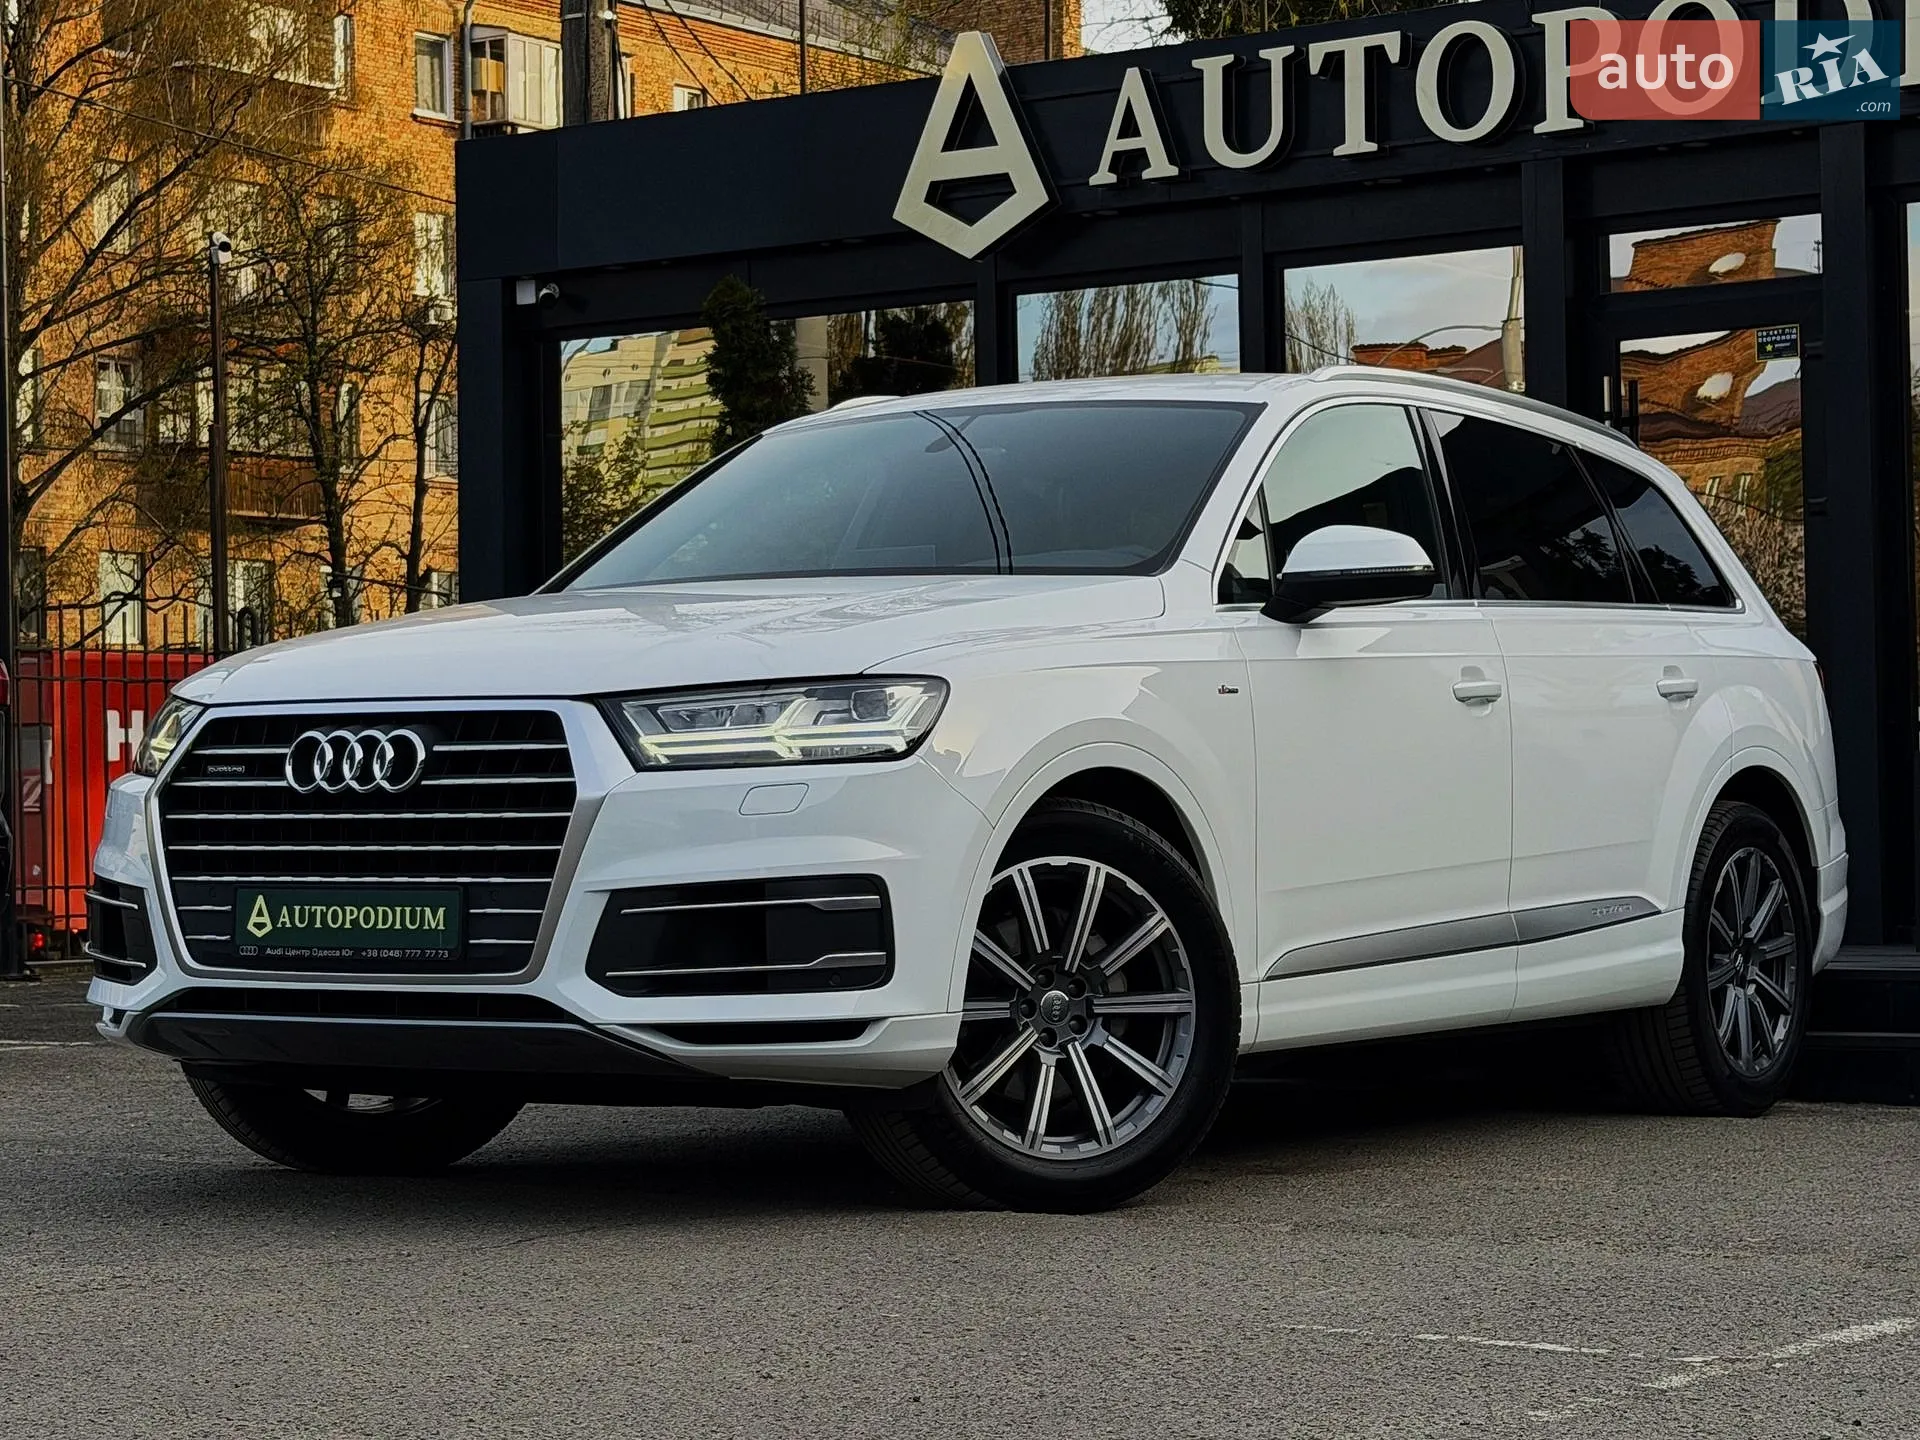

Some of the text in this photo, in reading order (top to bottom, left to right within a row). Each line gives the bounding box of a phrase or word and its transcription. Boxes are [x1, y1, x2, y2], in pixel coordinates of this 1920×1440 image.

[276, 905, 446, 930] AUTOPODIUM
[265, 947, 284, 956] Audi
[284, 947, 311, 958] Центр
[311, 948, 341, 958] Одесса
[341, 948, 354, 957] Юг
